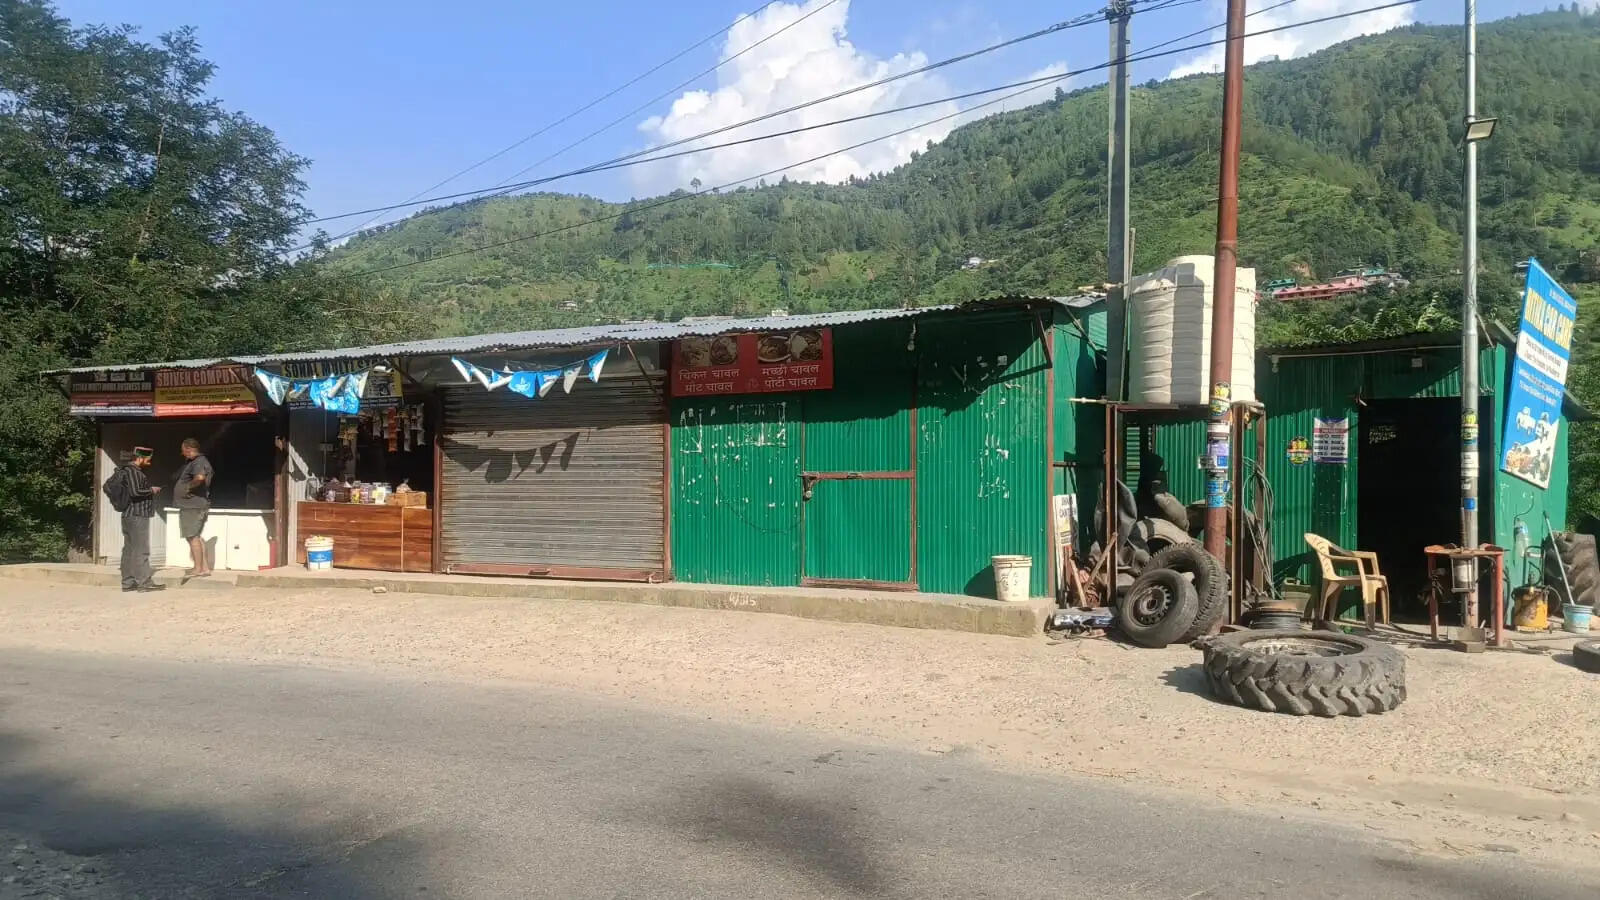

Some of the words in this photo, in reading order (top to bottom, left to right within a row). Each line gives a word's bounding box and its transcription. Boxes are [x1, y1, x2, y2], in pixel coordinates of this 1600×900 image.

[679, 369, 707, 381] चिकन
[712, 368, 740, 378] चावल
[790, 364, 820, 375] चावल
[704, 381, 734, 393] चावल
[787, 376, 817, 388] चावल
